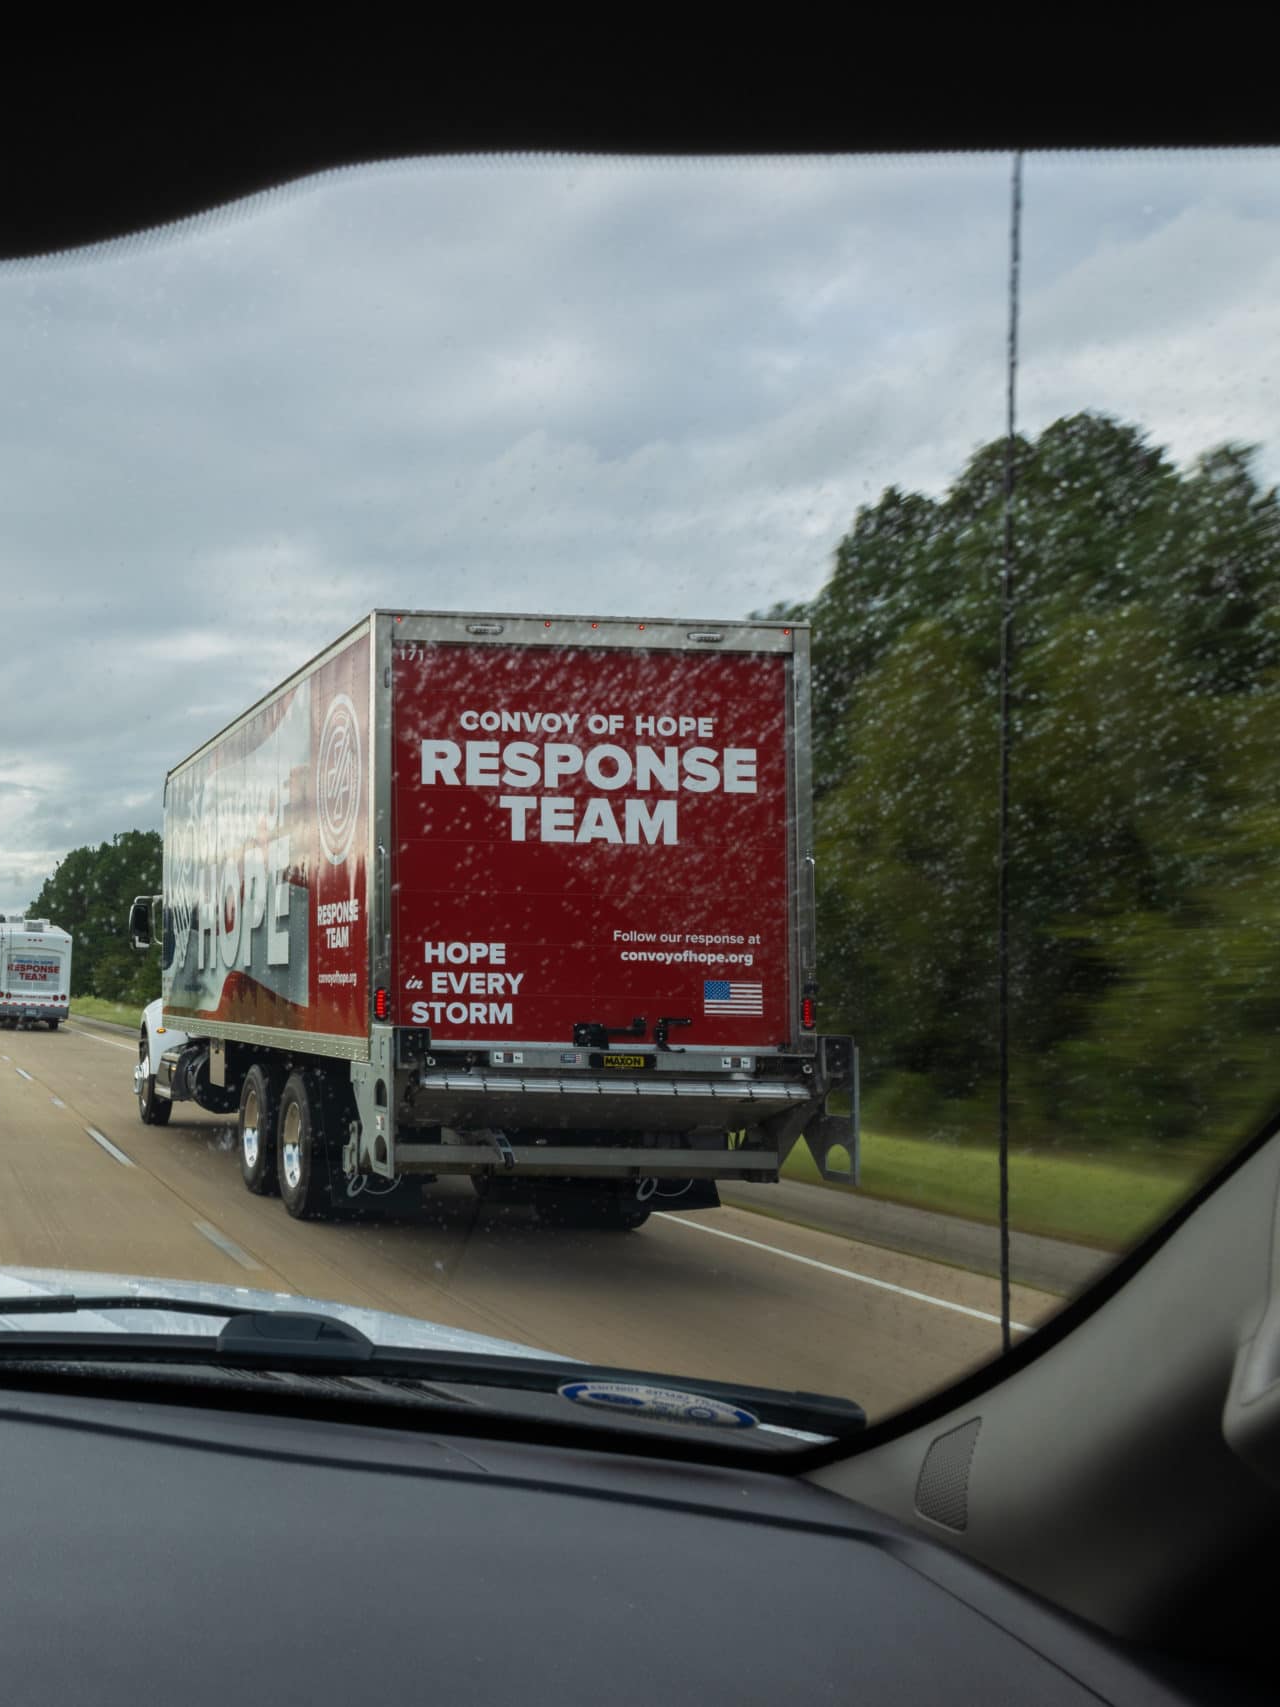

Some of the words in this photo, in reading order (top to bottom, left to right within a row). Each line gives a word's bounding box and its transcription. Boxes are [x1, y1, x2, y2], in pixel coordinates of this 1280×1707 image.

[400, 648, 424, 661] 171
[460, 710, 580, 734] CONVOY
[587, 714, 625, 735] OF
[635, 715, 714, 738] HOPE
[421, 739, 757, 793] RESPONSE
[499, 795, 678, 845] TEAM
[197, 833, 290, 970] HOPE
[317, 899, 359, 927] RESPONSE
[326, 926, 350, 949] TEAM
[613, 930, 657, 943] Follow
[660, 932, 682, 943] our
[685, 933, 744, 946] response
[748, 934, 761, 945] at
[424, 941, 506, 965] HOPE
[620, 950, 754, 967] convoyofhope.org
[7, 963, 61, 974] RESPONSE
[19, 972, 48, 981] TEAM
[405, 975, 424, 990] in
[431, 971, 524, 995] EVERY
[411, 1001, 514, 1025] STORM
[605, 1056, 642, 1066] MAXON
